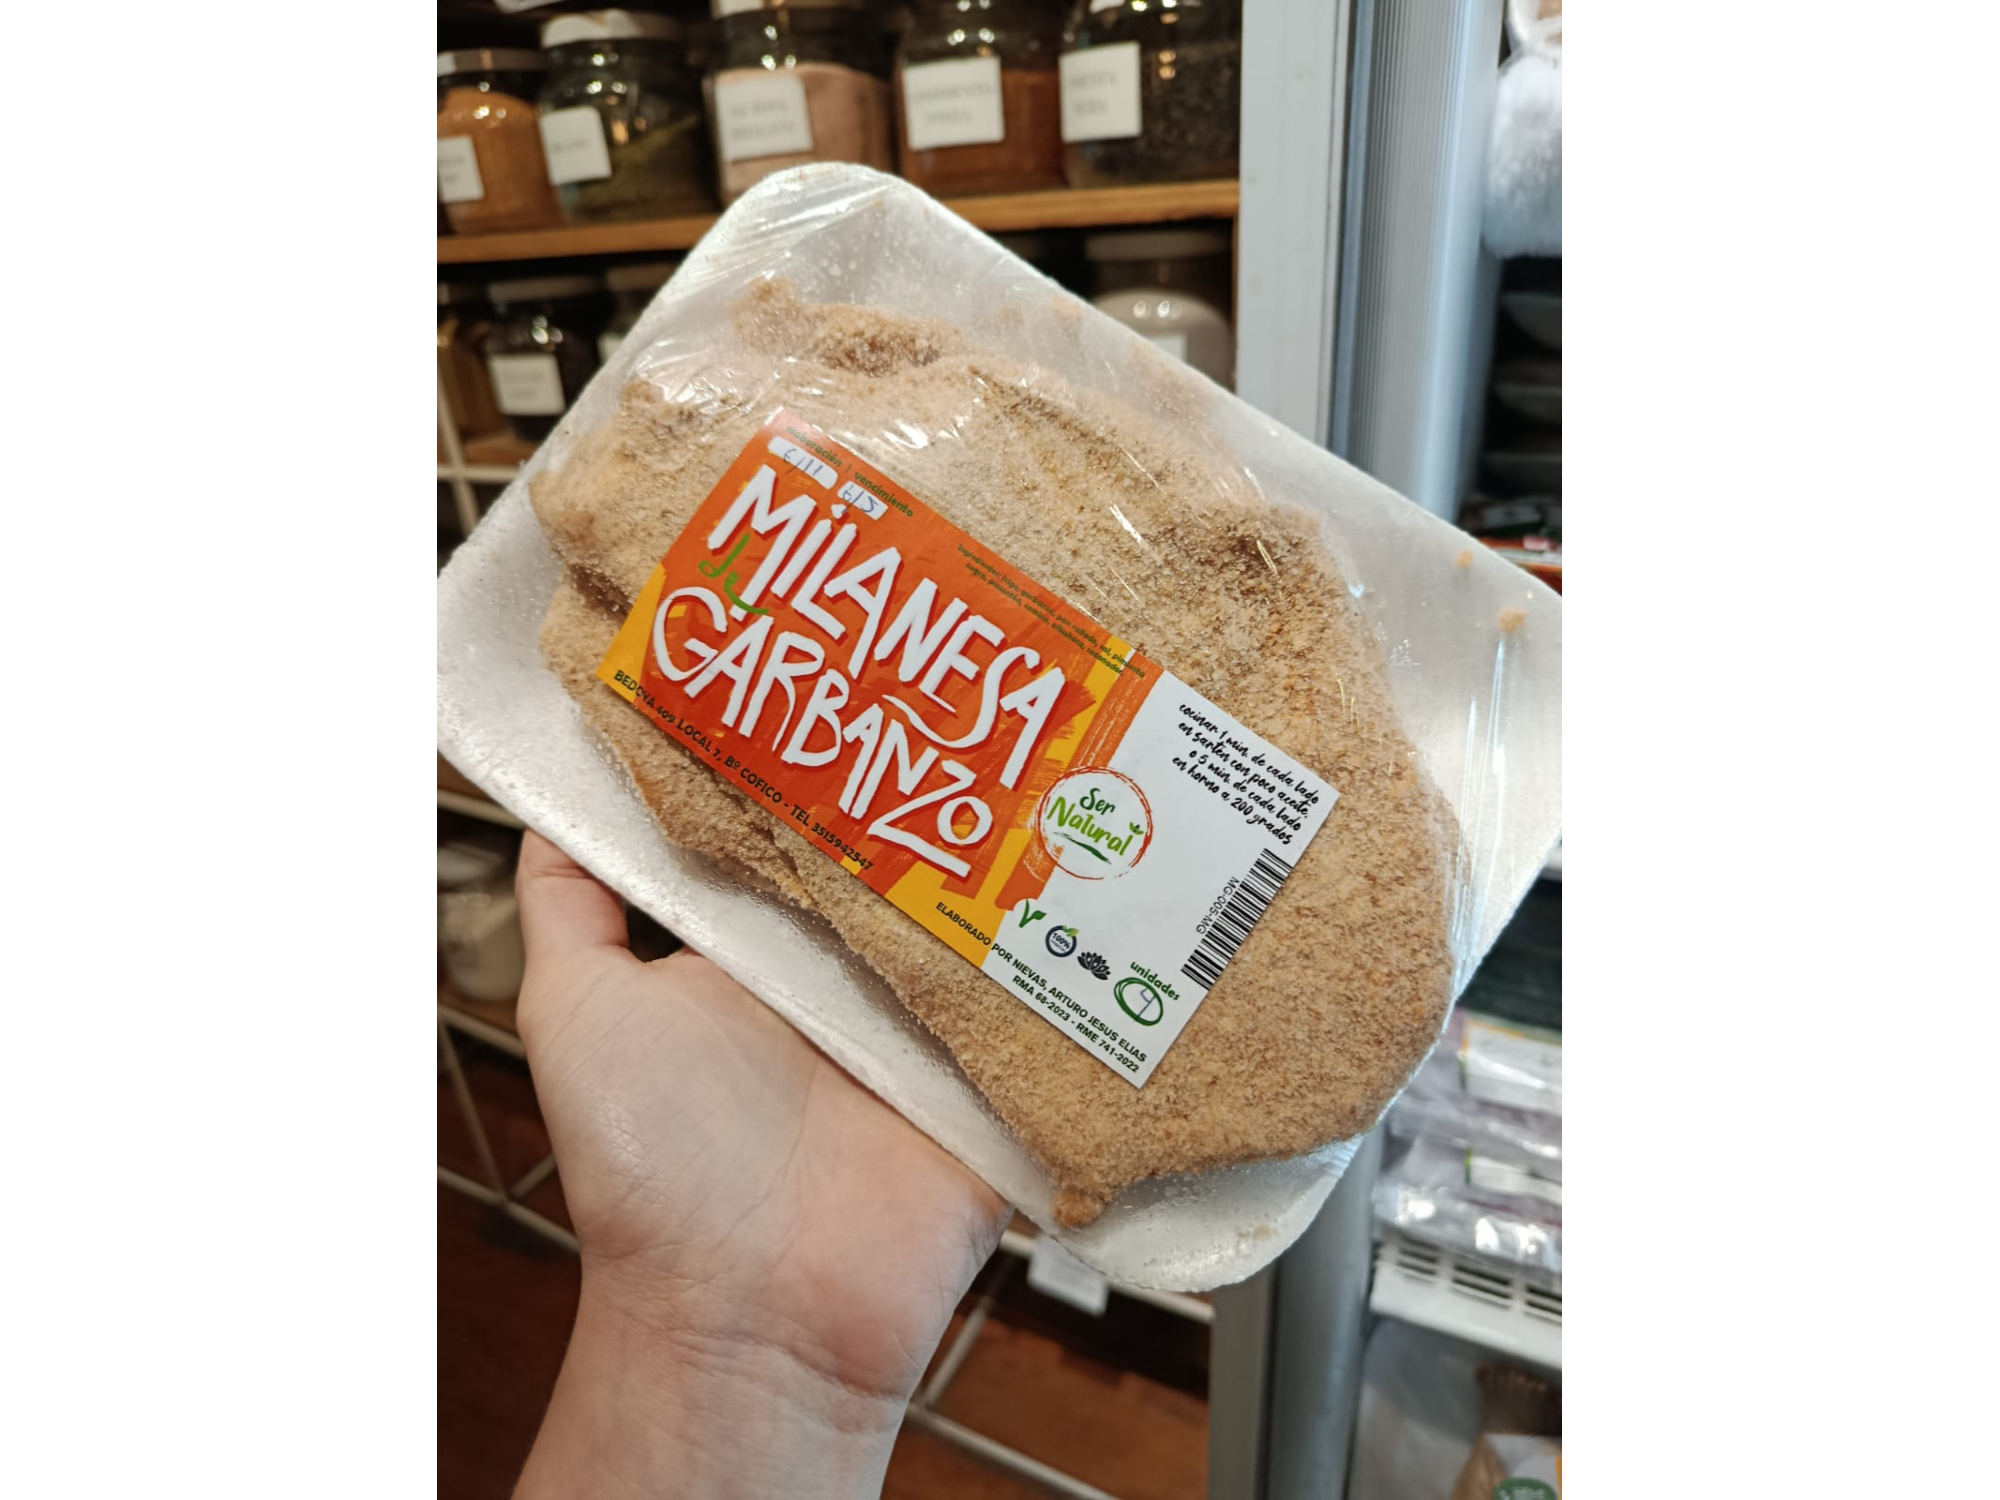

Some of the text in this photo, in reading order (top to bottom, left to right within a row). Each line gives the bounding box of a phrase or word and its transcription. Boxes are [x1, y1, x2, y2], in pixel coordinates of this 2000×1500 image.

[853, 471, 914, 518] vencimiento
[1055, 614, 1072, 627] pan
[653, 586, 993, 878] GARBANZO
[1178, 722, 1194, 737] en
[1191, 731, 1230, 763] sartén
[1230, 759, 1251, 777] con
[1246, 773, 1276, 794] poco
[1179, 704, 1319, 805] cocinar 1 min. de cada lado
[613, 669, 655, 709] BEDOYA
[655, 706, 676, 724] 409
[676, 718, 712, 753] LOCAL
[712, 747, 722, 762] 7,
[739, 767, 783, 804] COFICO
[790, 804, 811, 827] TEL
[811, 822, 874, 871] 3515942547
[1079, 787, 1116, 816] Ser
[1172, 757, 1293, 845] en horno a 200 grados
[1188, 750, 1301, 831] o 5 min. de cada lado
[1047, 796, 1138, 856] Natural
[1053, 931, 1072, 950] 100%
[1195, 876, 1240, 935] MG-005-MG
[935, 901, 1147, 1062] ELABORADO POR NIEVAS, ARTURO JESUS ELIAS
[1130, 961, 1180, 1001] unidades
[1012, 974, 1035, 996] RMA
[1034, 992, 1071, 1022] 68-2023
[1075, 1022, 1100, 1043] RME
[1098, 1039, 1140, 1073] 741-2022
